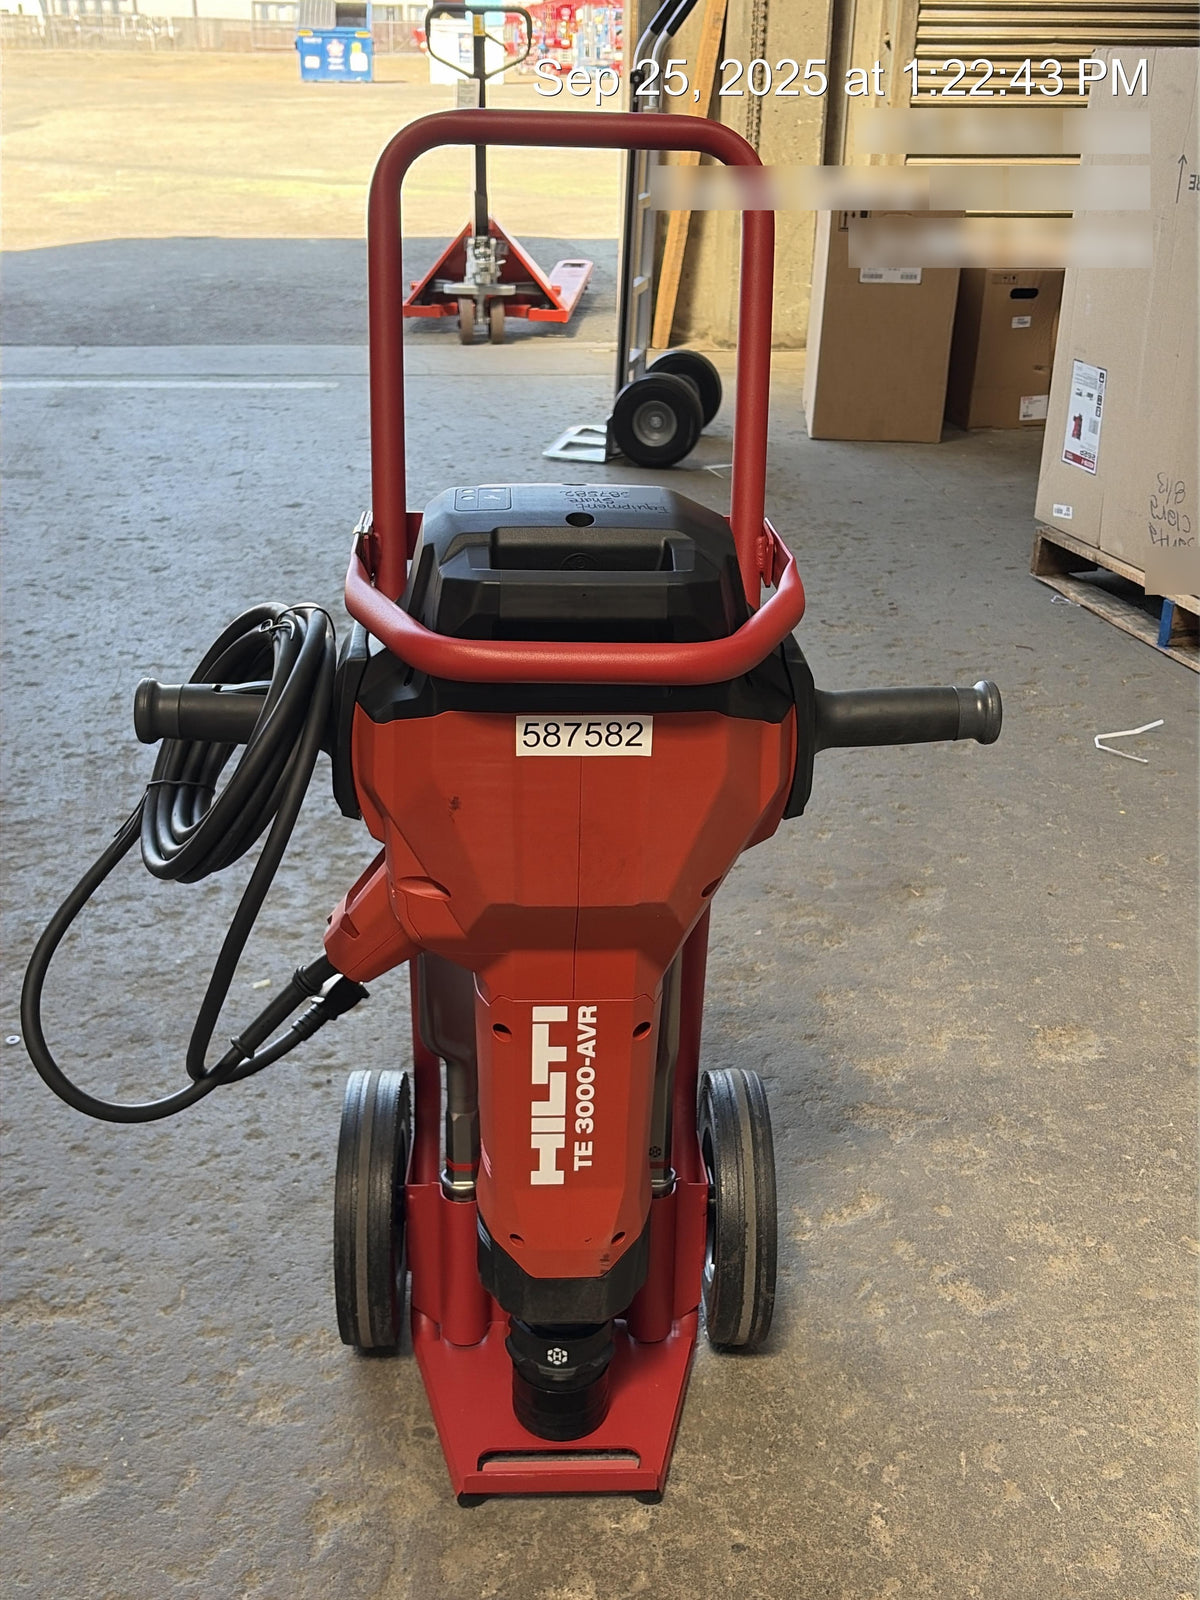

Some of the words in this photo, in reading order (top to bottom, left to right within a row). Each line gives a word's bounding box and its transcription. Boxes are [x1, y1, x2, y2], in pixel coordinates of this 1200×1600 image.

[522, 721, 644, 748] 587582
[530, 1005, 569, 1185] HILTI
[575, 1005, 598, 1134] 3000-AVR
[573, 1141, 593, 1172] TE
